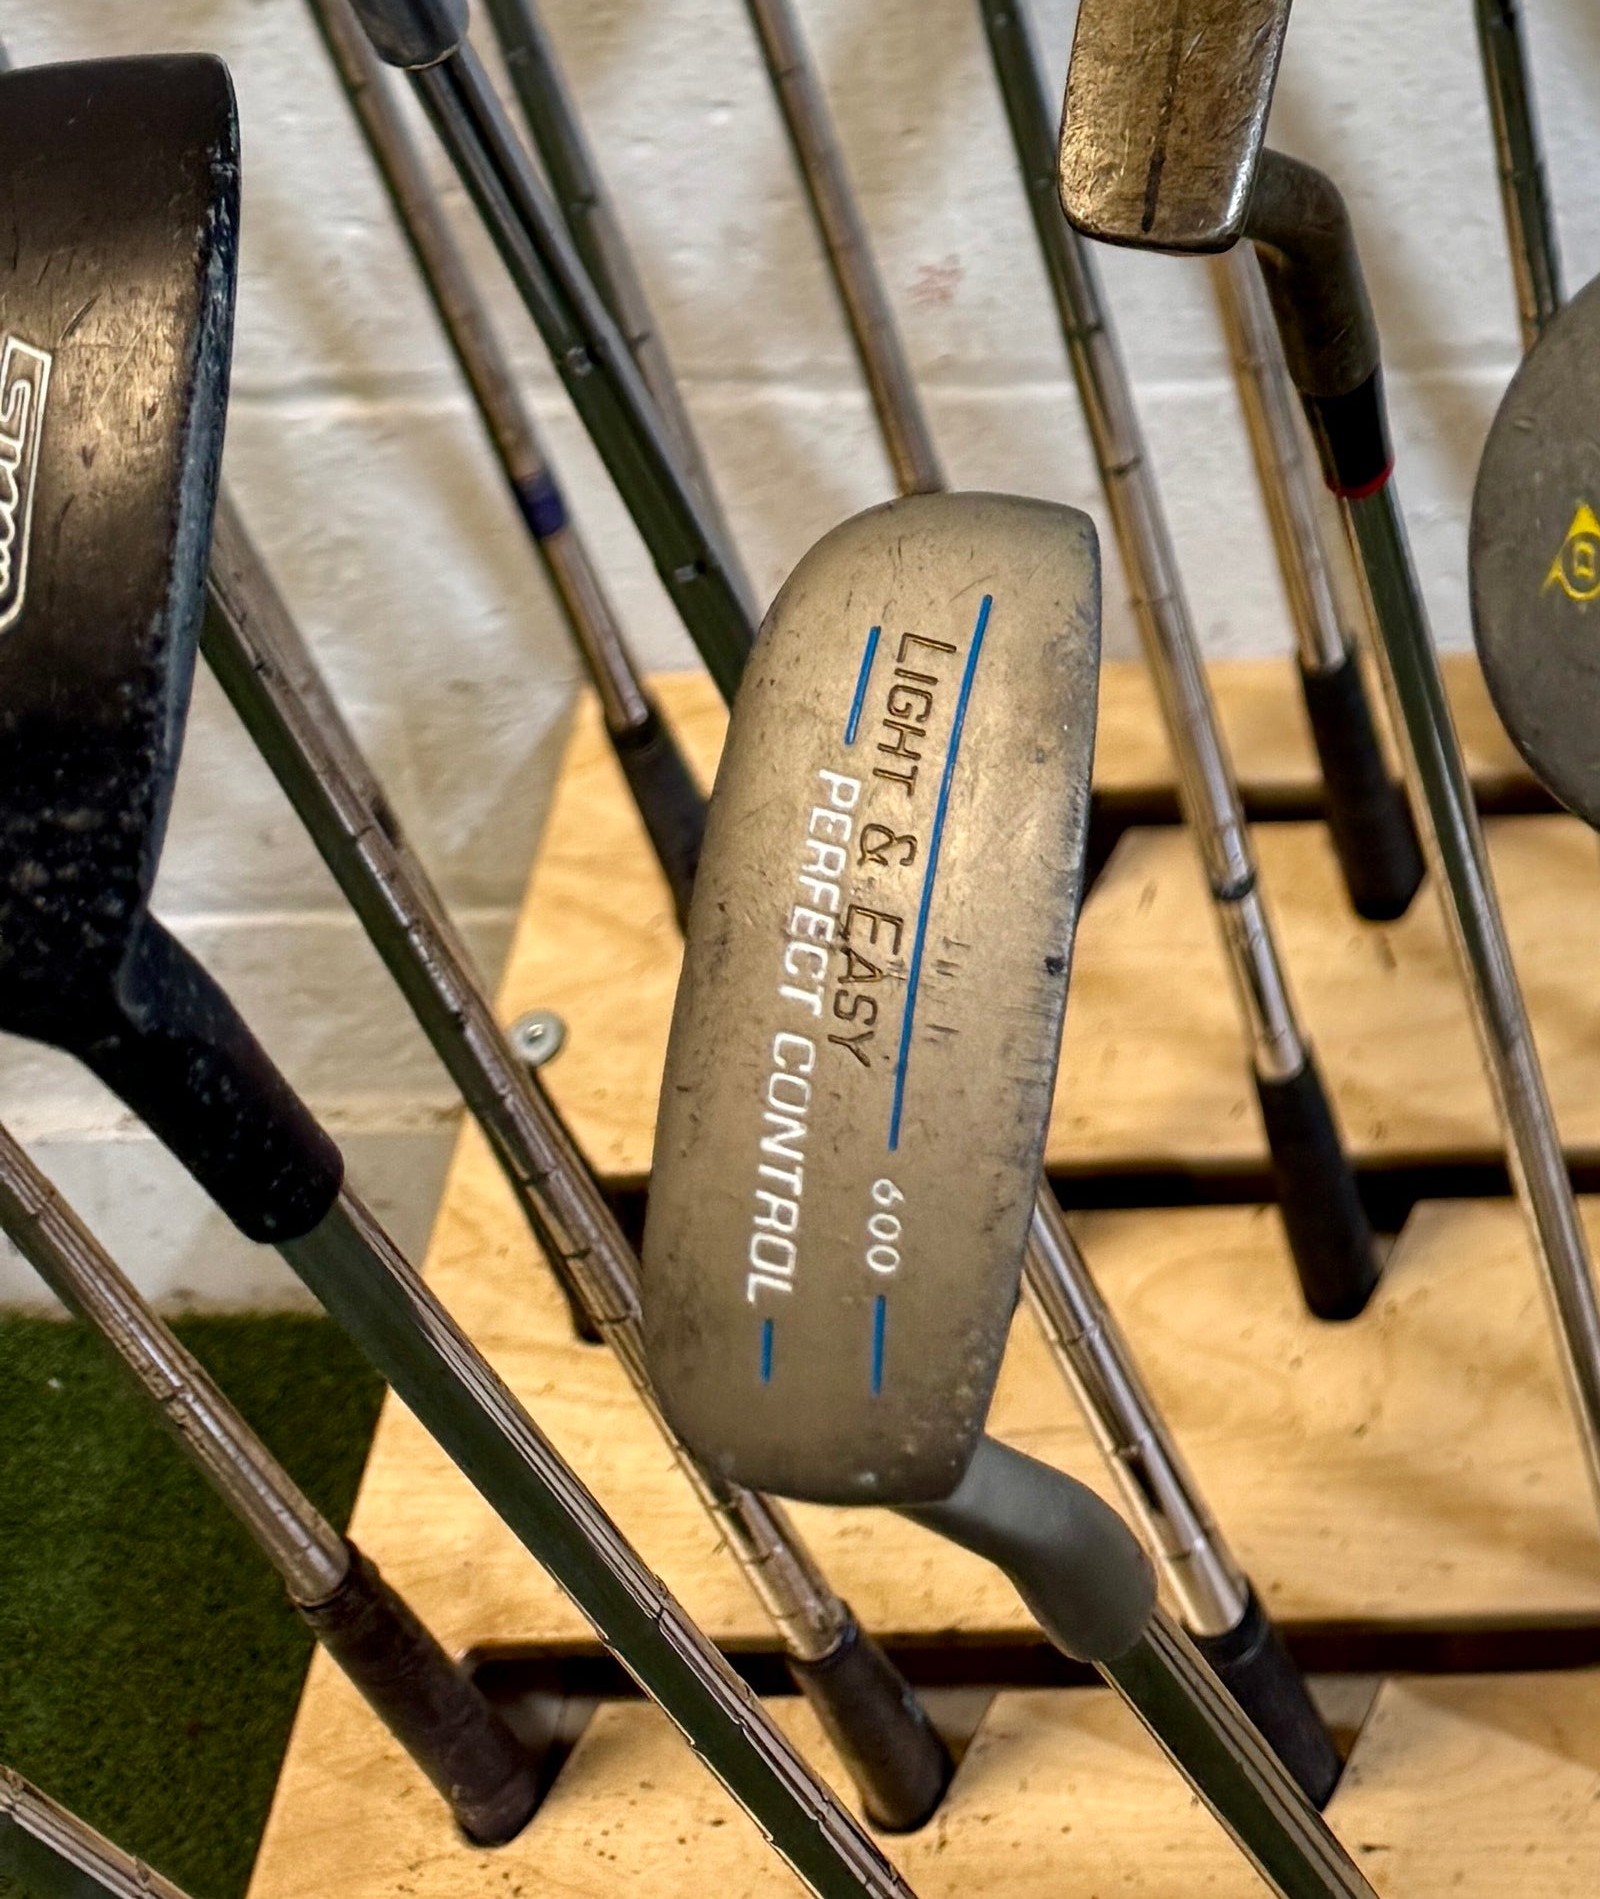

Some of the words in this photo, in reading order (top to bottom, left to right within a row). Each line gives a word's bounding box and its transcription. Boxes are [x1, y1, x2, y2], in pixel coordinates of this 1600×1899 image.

[872, 632, 957, 798] LIGHT
[777, 769, 862, 1018] PERFECT
[857, 822, 918, 868] &
[827, 903, 905, 1068] EASY
[747, 1031, 816, 1304] CONTROL
[866, 1178, 905, 1274] 600
